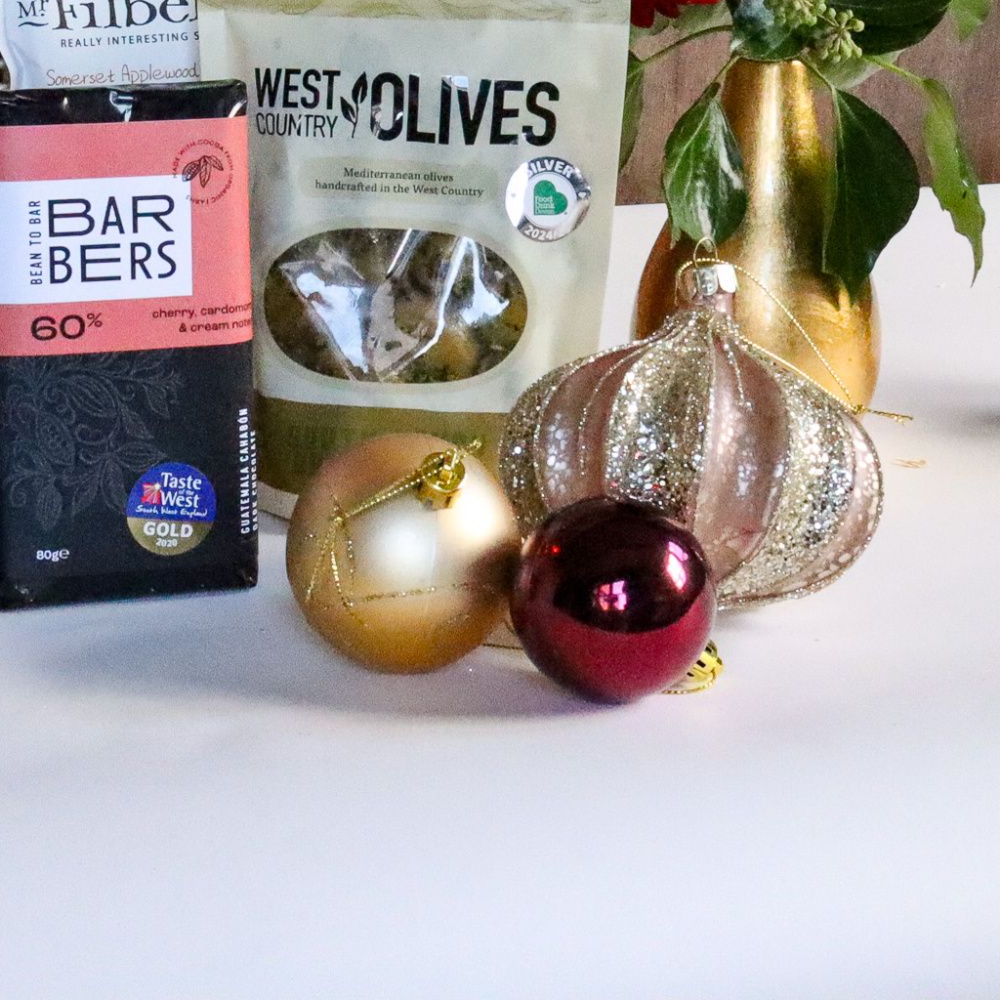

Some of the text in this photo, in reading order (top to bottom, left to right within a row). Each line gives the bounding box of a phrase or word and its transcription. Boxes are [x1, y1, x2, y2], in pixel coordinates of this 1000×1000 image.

[60, 37, 102, 48] REALLY
[107, 32, 189, 46] INTERESTING
[47, 64, 200, 86] Somerset Applewood
[254, 67, 341, 110] WEST
[369, 71, 560, 147] OLIVES
[255, 112, 339, 138] COUNTRY
[198, 138, 224, 152] COCOA
[343, 166, 455, 182] Mediterranean olives
[314, 179, 485, 198] handcrafted in the West Country
[48, 194, 175, 238] BAR
[28, 200, 43, 286] BEAN TO BAR
[49, 240, 177, 285] BERS
[30, 312, 103, 342] 60%
[178, 322, 187, 333] &
[190, 321, 230, 332] cream
[160, 472, 202, 490] Taste
[160, 490, 200, 508] West
[240, 466, 251, 534] GUATEMALA
[135, 504, 159, 515] South
[180, 508, 208, 518] England
[143, 521, 194, 538] GOLD
[155, 538, 178, 547] 2020
